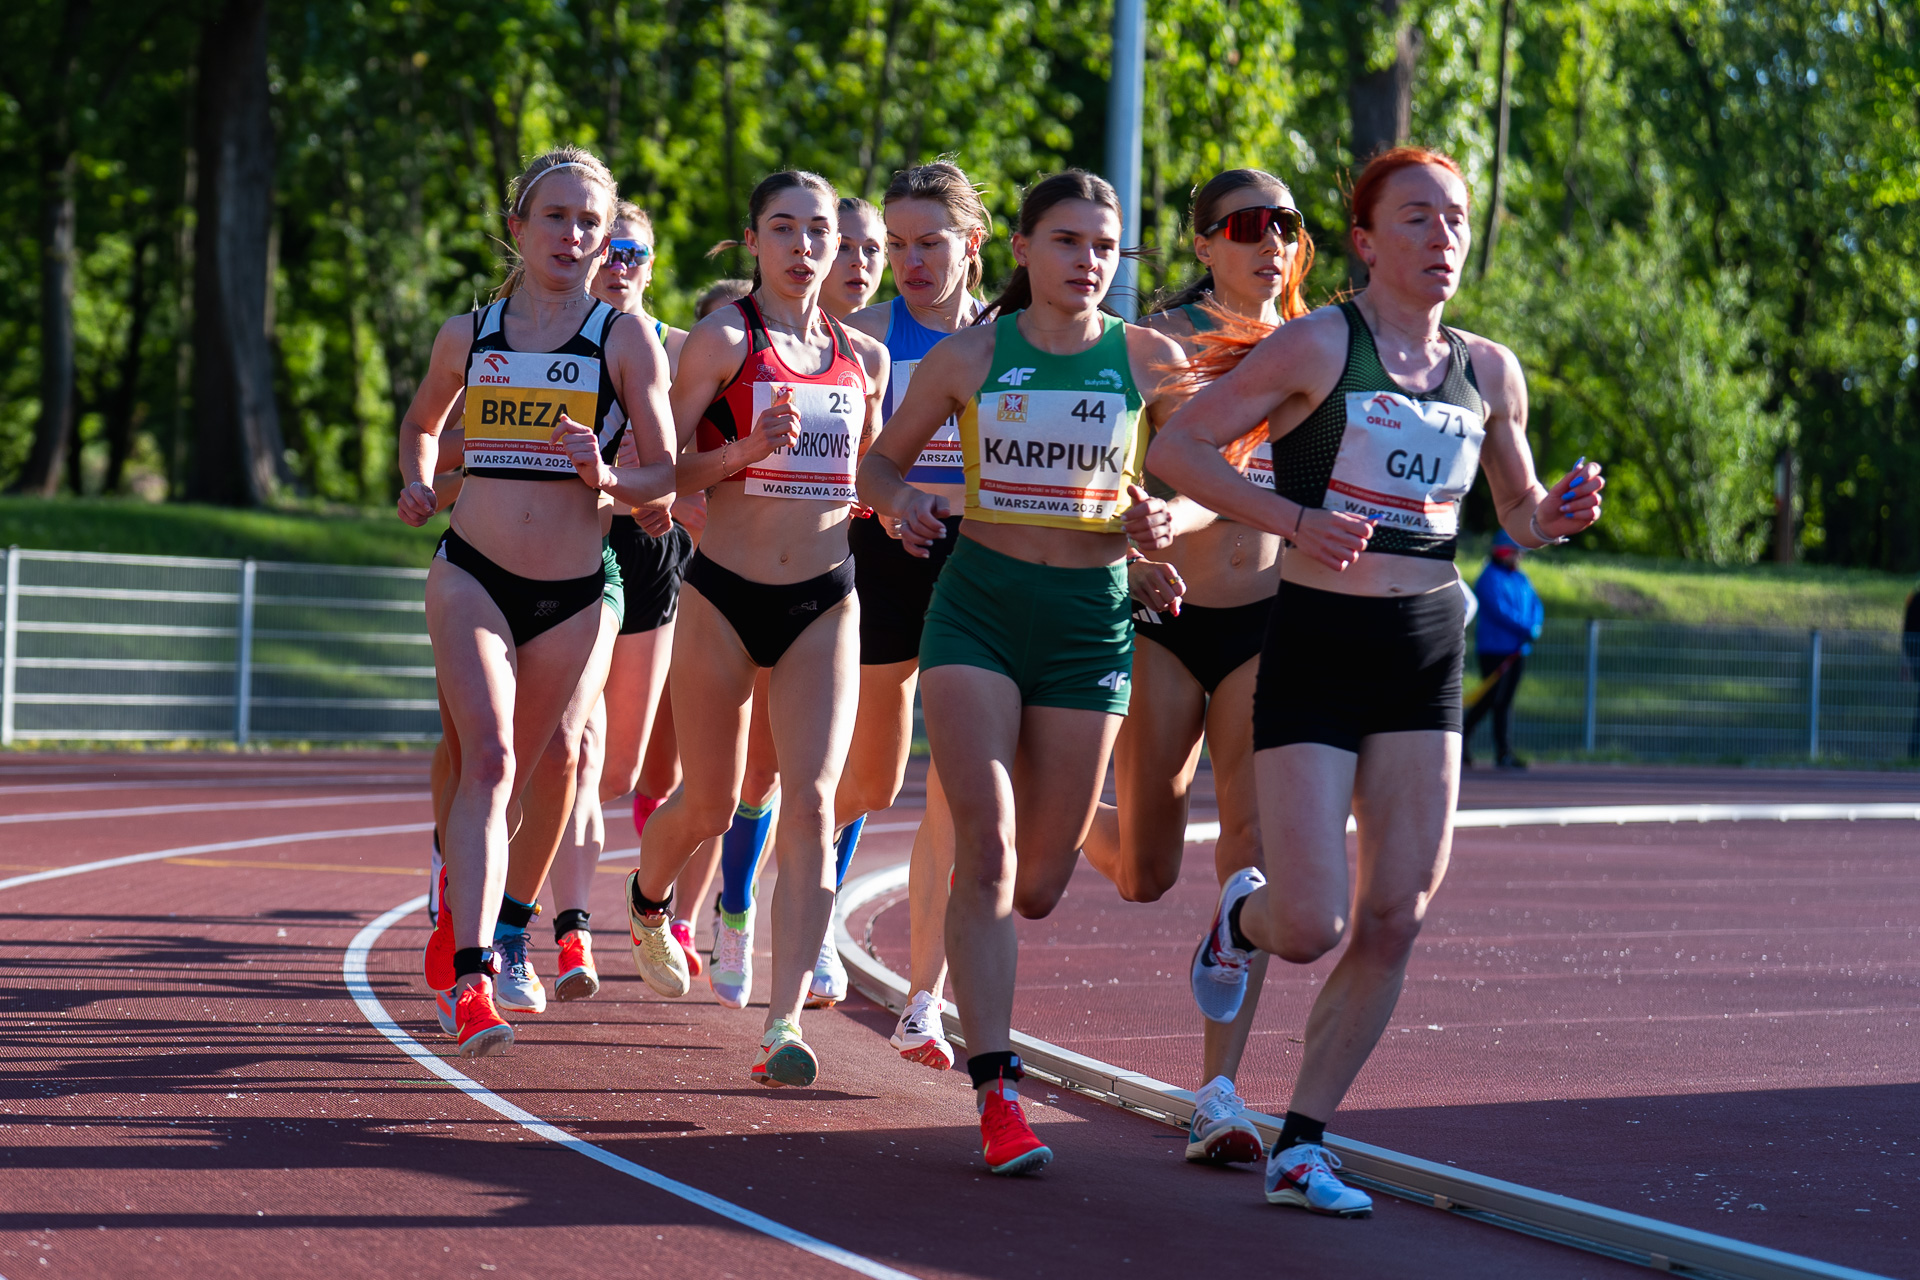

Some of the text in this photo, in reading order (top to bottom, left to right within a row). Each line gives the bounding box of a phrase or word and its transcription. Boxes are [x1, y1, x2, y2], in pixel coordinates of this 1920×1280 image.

[479, 375, 510, 384] ORLEN
[546, 361, 579, 384] 60
[997, 367, 1037, 386] 4F
[828, 392, 852, 414] 25
[1071, 399, 1106, 423] 44
[481, 399, 570, 428] BREZA
[1366, 415, 1402, 430] ORLEN
[1438, 410, 1466, 439] 71
[473, 454, 574, 468] WARSZAWA 2025
[984, 437, 1120, 473] KARPIUK
[765, 471, 795, 479] Mistrzostwa
[1386, 449, 1441, 485] GAJ
[763, 483, 831, 497] WARSZAWA
[994, 496, 1104, 514] WARSZAWA 2025
